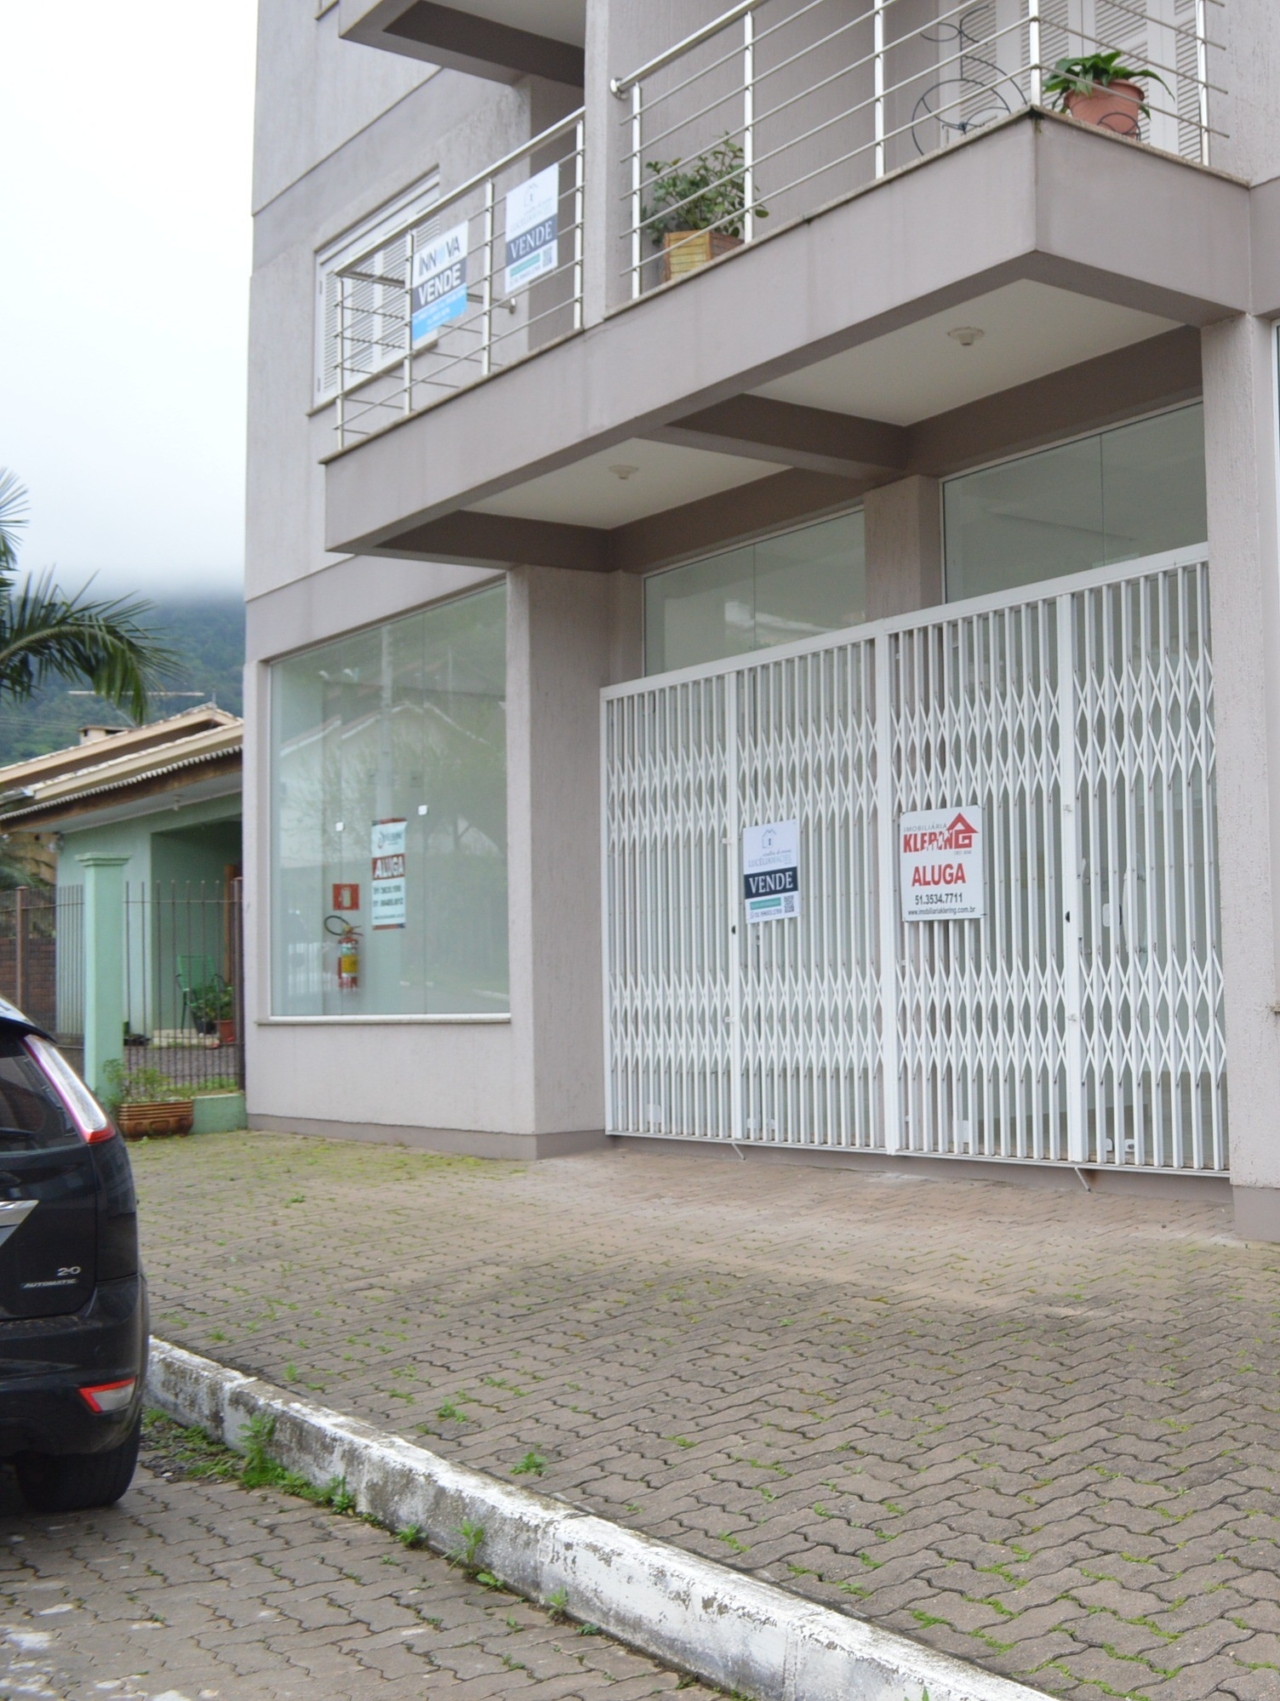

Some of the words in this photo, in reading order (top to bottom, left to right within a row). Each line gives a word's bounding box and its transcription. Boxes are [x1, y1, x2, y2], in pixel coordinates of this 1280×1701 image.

[510, 220, 553, 259] VENDE
[418, 263, 462, 306] VENDE
[903, 822, 947, 833] IMOBILIÁRIA
[374, 856, 404, 878] ALUGA
[911, 863, 967, 887] ALUGA
[749, 871, 794, 894] VENDE
[914, 892, 964, 906] 51.3534.7711
